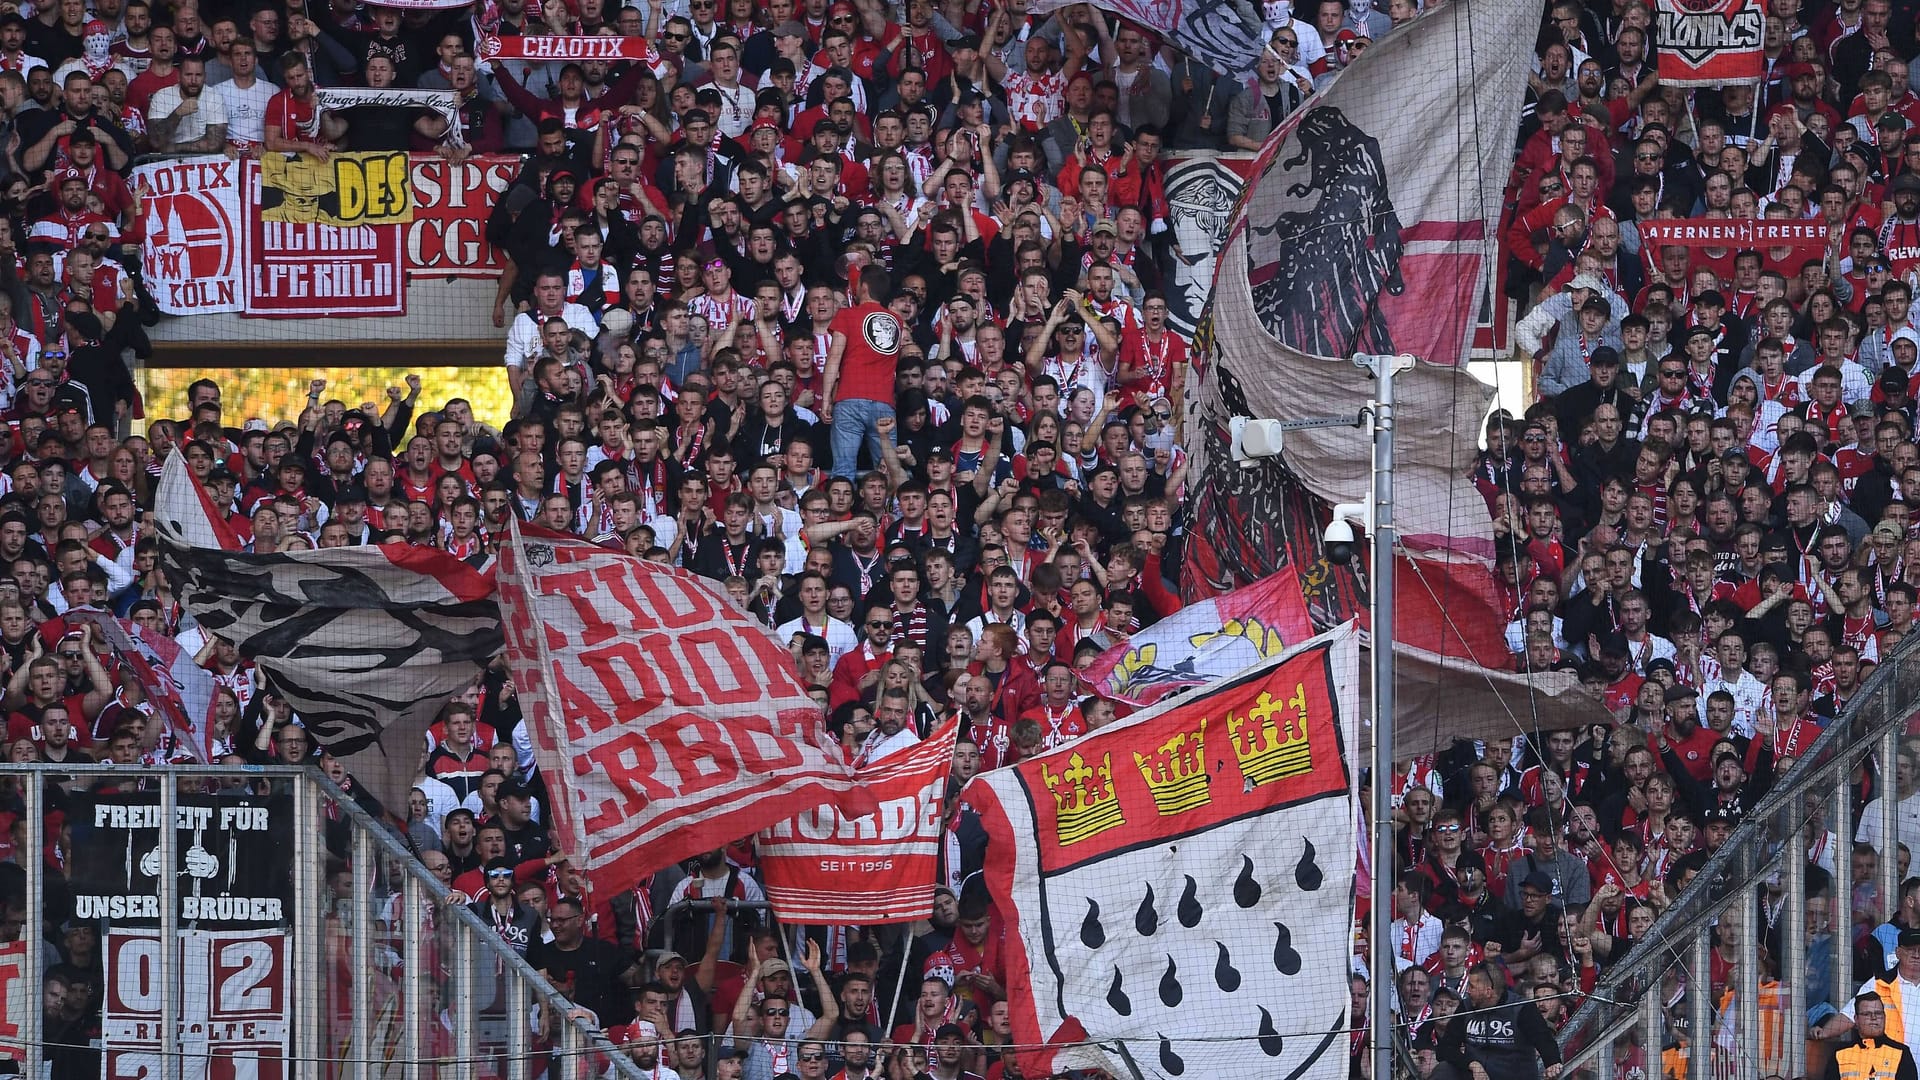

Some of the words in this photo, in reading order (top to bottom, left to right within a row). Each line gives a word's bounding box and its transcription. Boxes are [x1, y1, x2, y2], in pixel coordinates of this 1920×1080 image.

[523, 37, 624, 57] CHAOTIX
[334, 152, 409, 221] DES
[169, 279, 235, 308] KÖLN
[313, 261, 392, 297] KÖLN
[220, 801, 269, 831] FÜR
[758, 777, 945, 841] ORDE
[820, 861, 857, 872] SEIT
[860, 859, 893, 872] 1996
[76, 895, 161, 919] UNSER
[182, 892, 283, 921] BRÜDER
[220, 940, 274, 1012] 2
